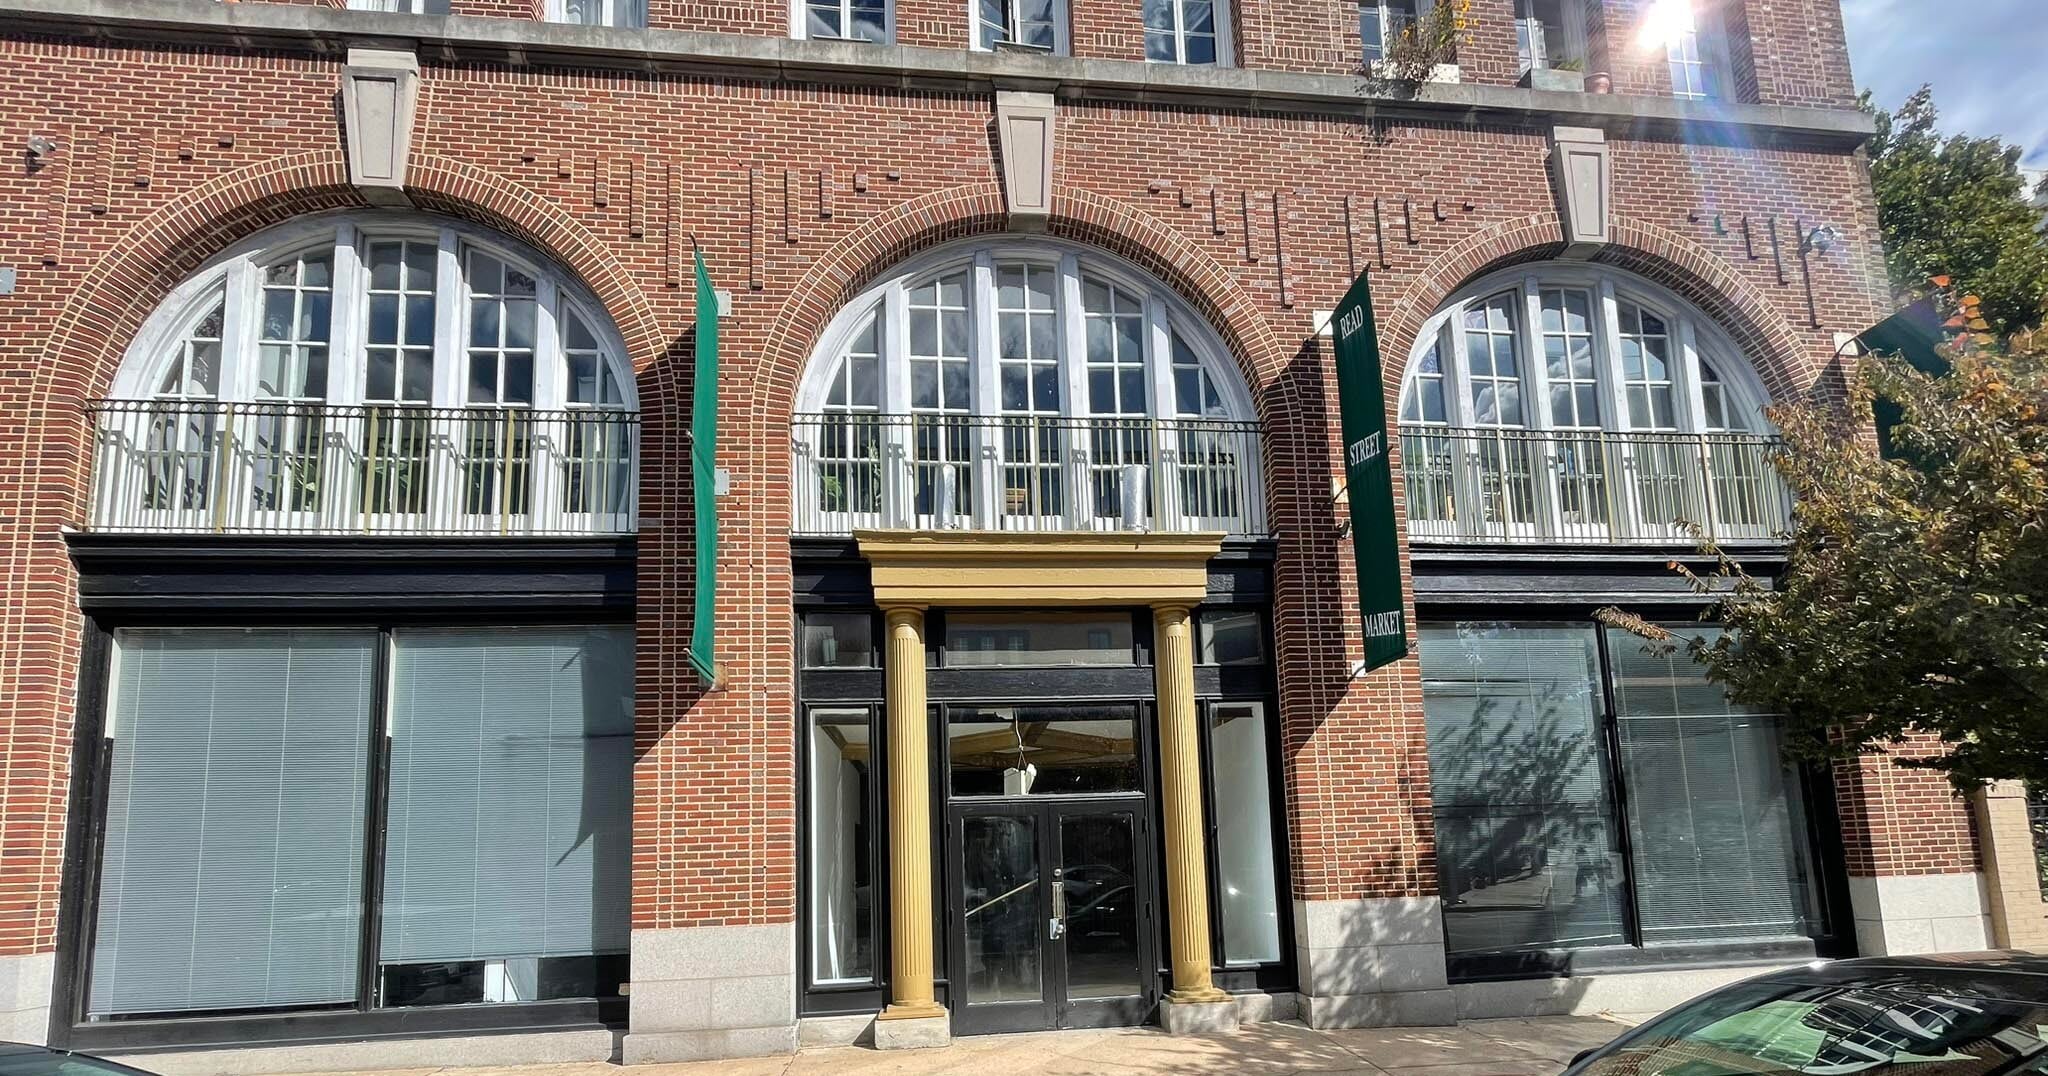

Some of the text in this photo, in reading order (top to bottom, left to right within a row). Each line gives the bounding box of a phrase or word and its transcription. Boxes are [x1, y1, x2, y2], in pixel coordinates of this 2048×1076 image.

[1340, 305, 1363, 339] READ
[1350, 431, 1381, 466] STREET
[1364, 611, 1400, 637] MARKET
